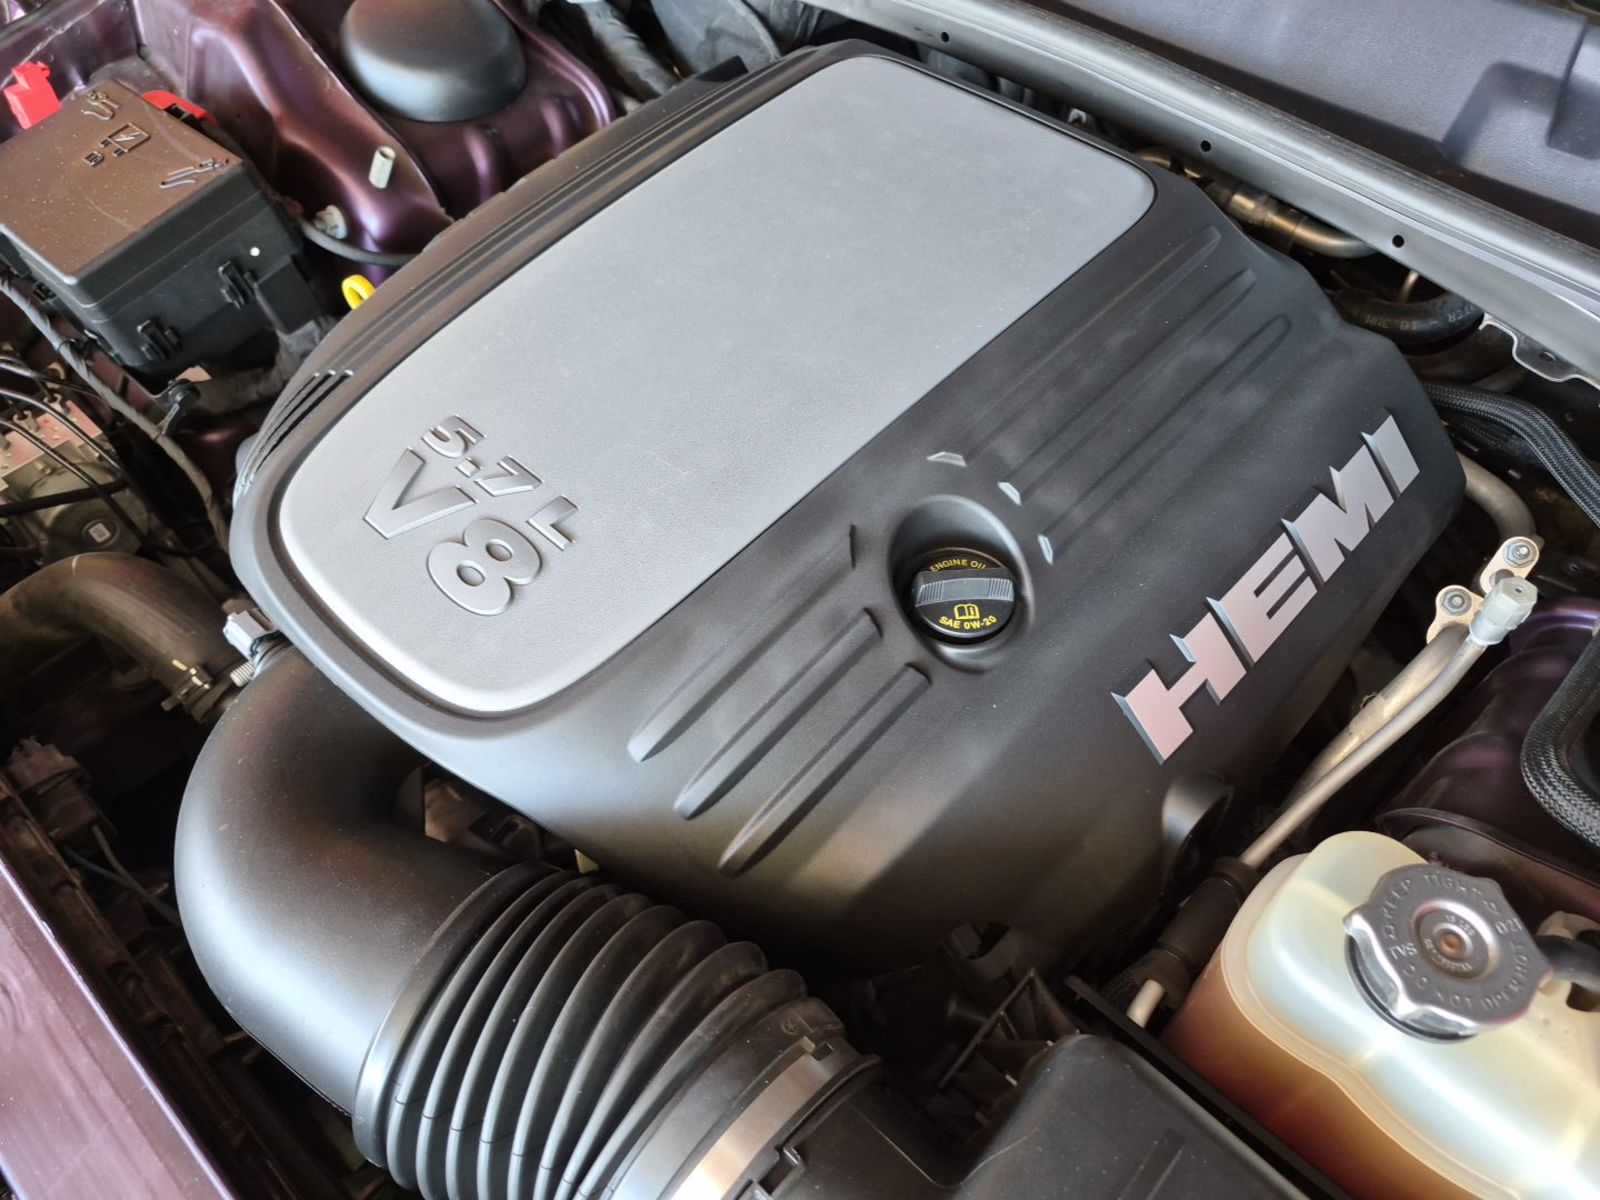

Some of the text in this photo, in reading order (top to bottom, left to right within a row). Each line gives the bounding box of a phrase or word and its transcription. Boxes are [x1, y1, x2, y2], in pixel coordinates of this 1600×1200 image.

[363, 447, 544, 617] V8
[928, 558, 968, 572] ENGINE
[1110, 414, 1421, 765] HEMI
[939, 615, 998, 630] SAE 0W-20
[1389, 942, 1418, 960] TVS
